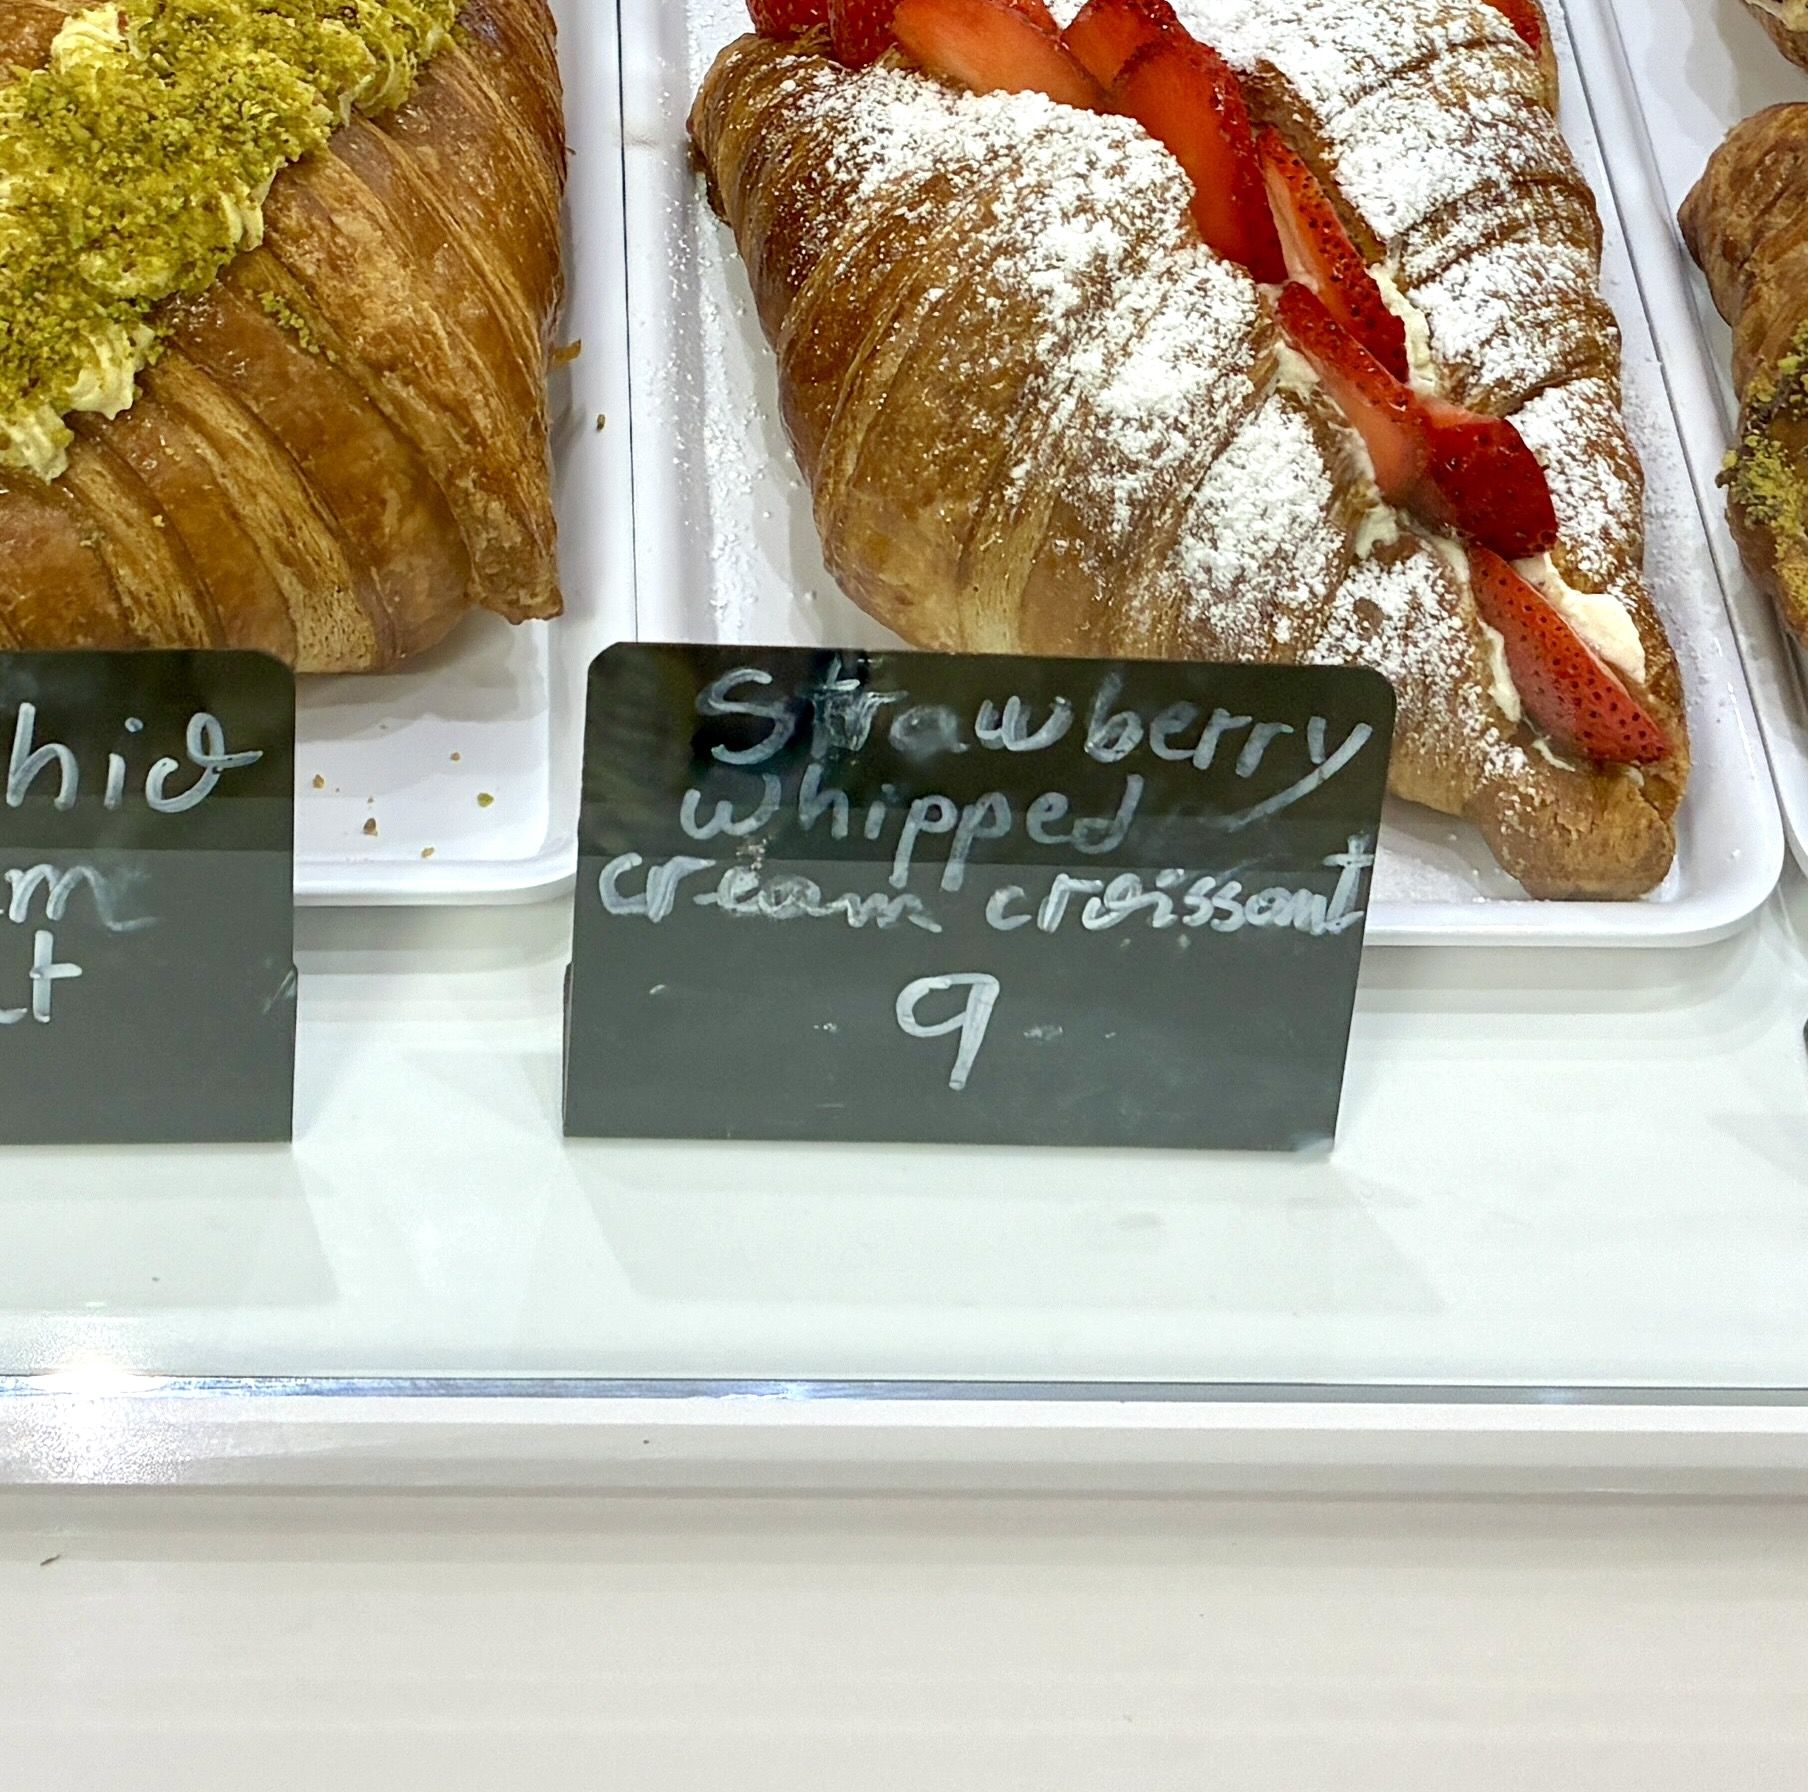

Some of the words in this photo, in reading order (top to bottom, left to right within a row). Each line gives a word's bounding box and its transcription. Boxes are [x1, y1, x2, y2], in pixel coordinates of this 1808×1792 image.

[695, 658, 1374, 830] Strawberry
[597, 851, 944, 935] cream
[985, 832, 1376, 936] croissant
[679, 764, 1146, 893] whipped
[894, 970, 1002, 1092] 9
